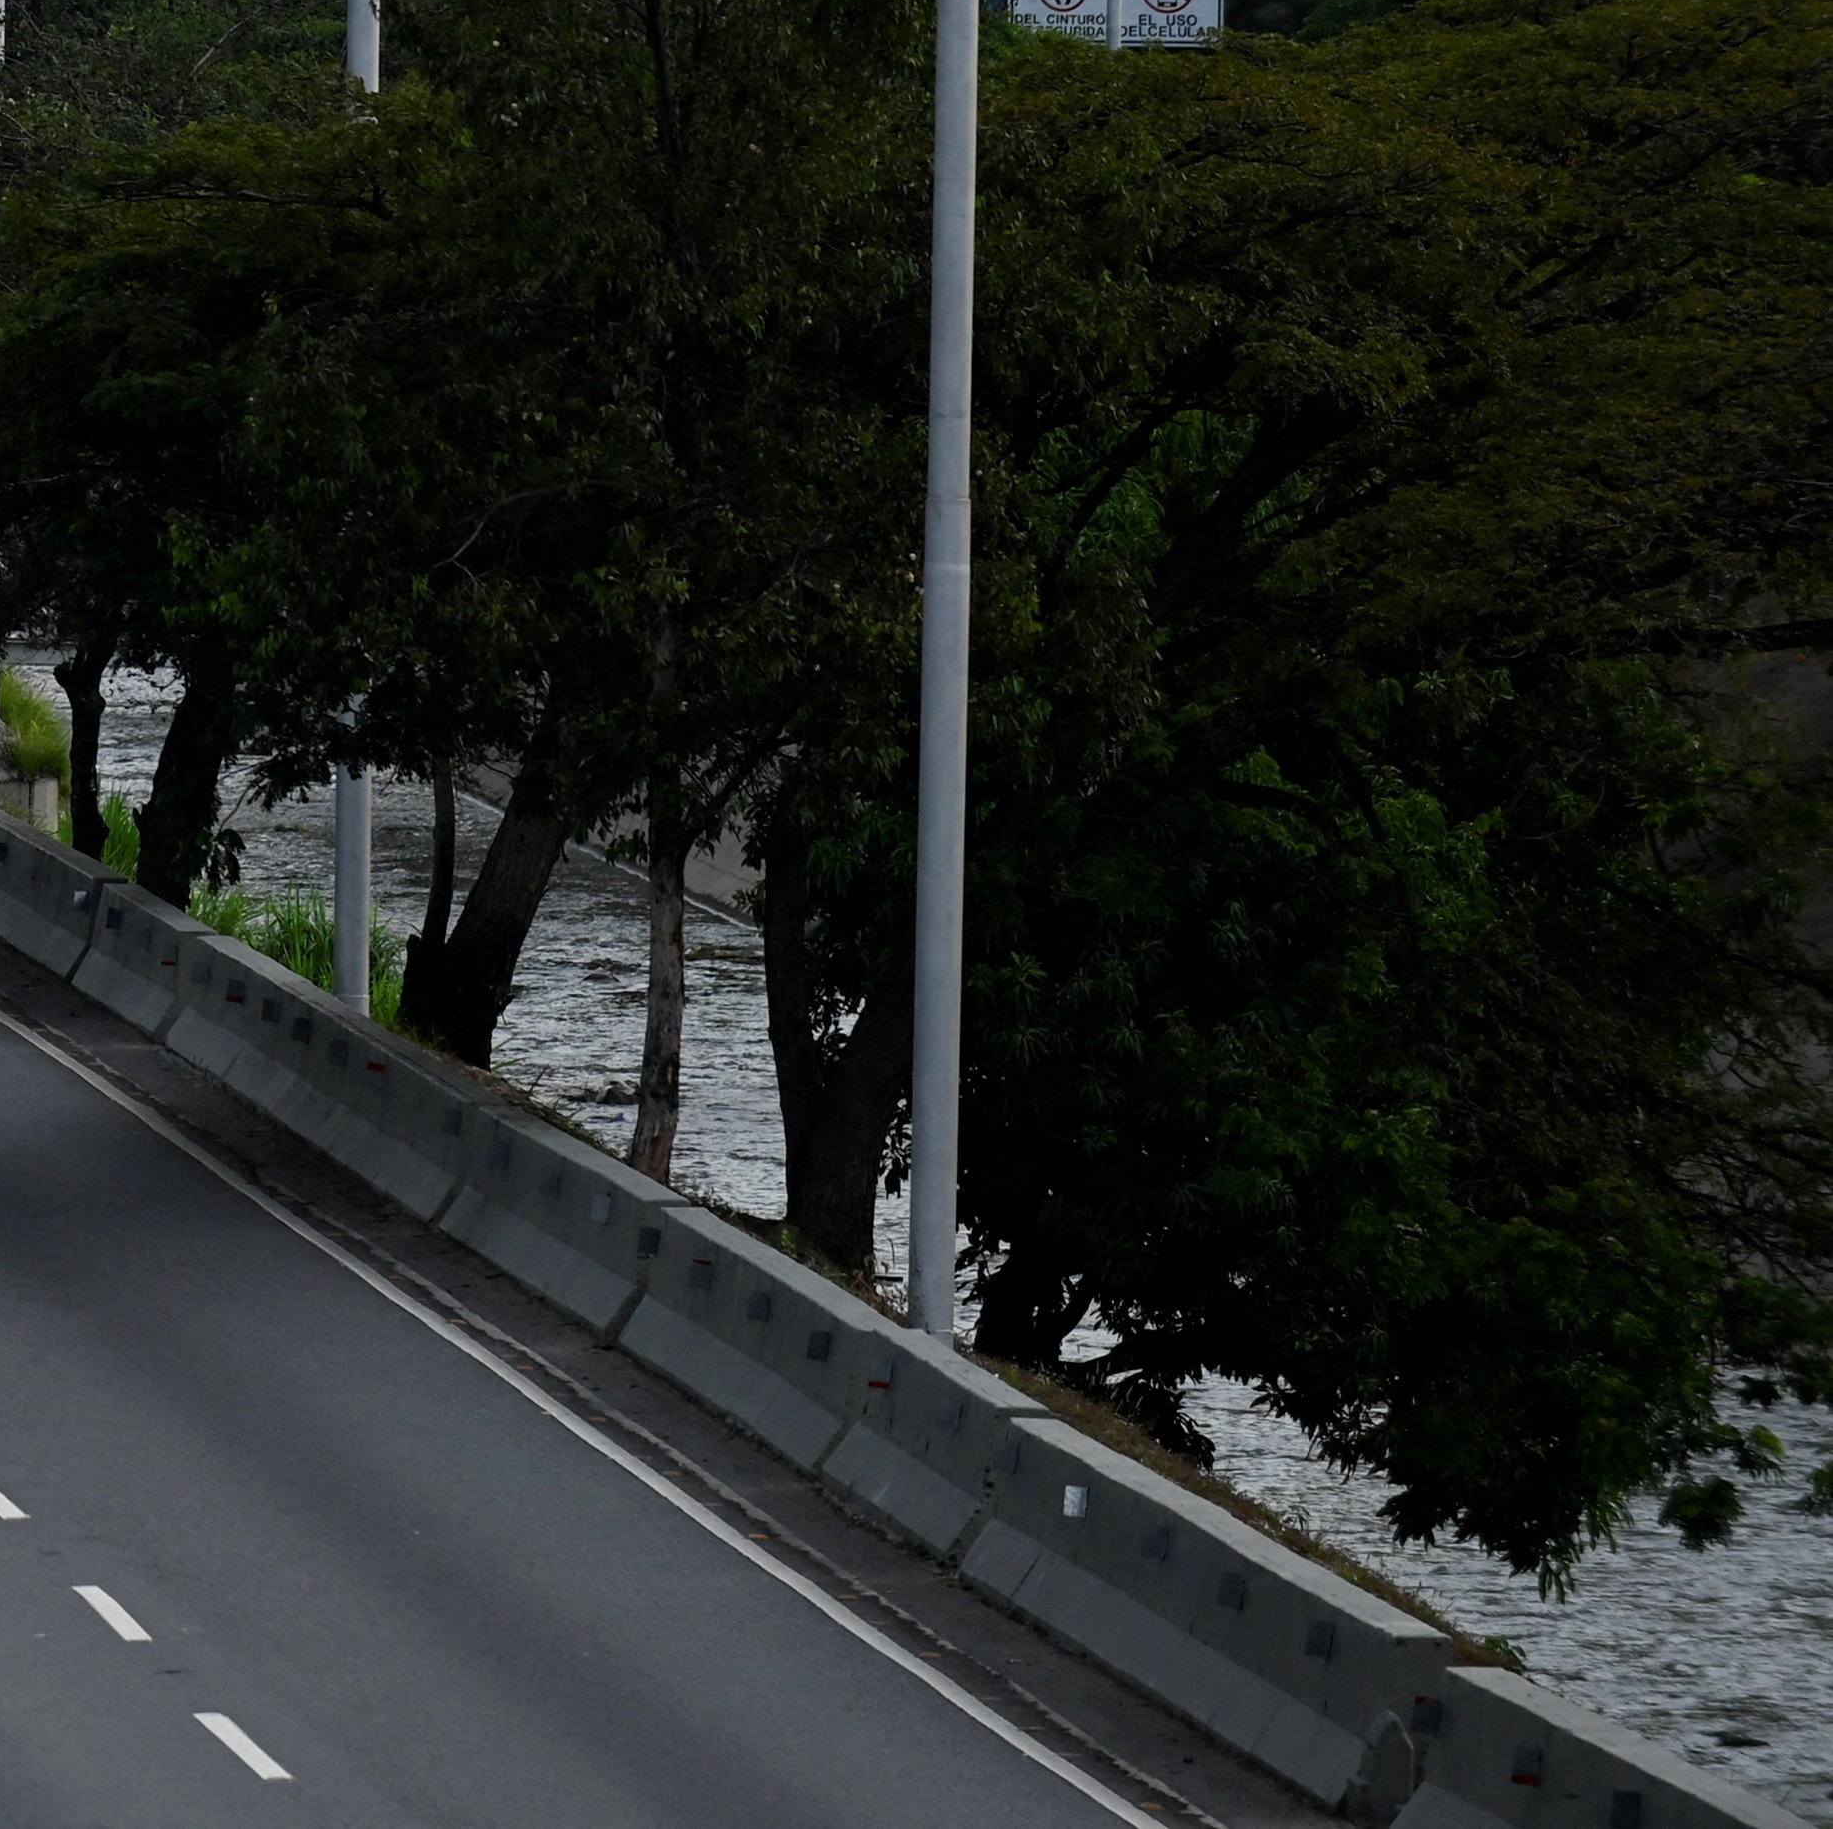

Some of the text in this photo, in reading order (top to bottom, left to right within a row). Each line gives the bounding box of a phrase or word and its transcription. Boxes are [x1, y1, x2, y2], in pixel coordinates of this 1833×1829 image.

[1046, 13, 1106, 25] CINTURÓ
[1138, 14, 1198, 26] EL USO
